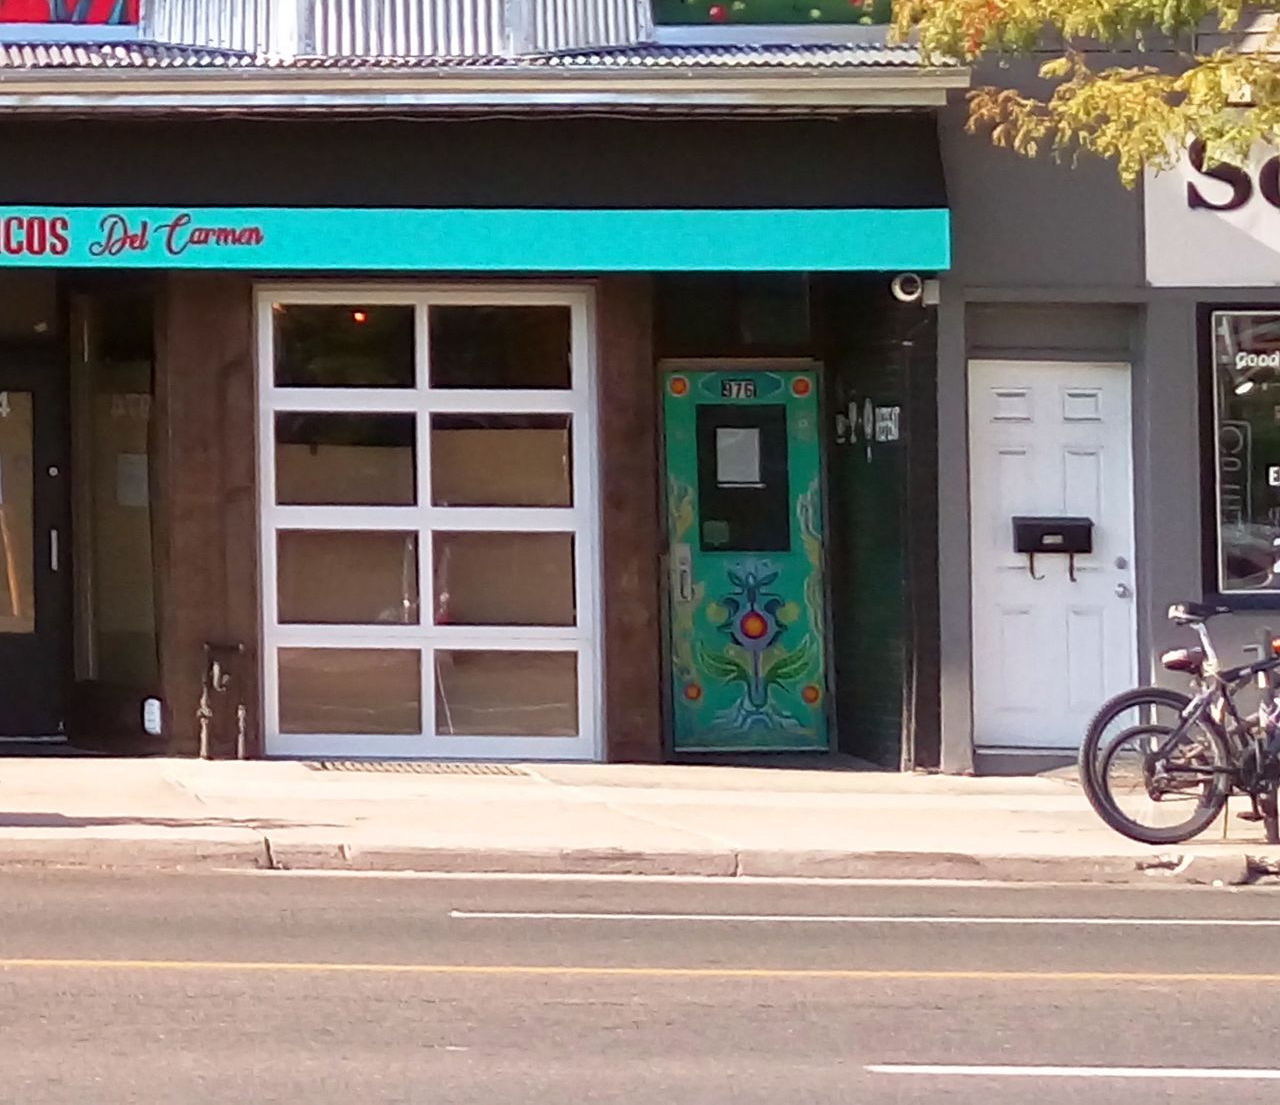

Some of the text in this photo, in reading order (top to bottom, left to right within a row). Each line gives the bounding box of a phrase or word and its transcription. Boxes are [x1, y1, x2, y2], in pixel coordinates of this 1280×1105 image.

[88, 213, 148, 258] Del
[154, 213, 264, 257] Carmen
[721, 380, 756, 399] 976
